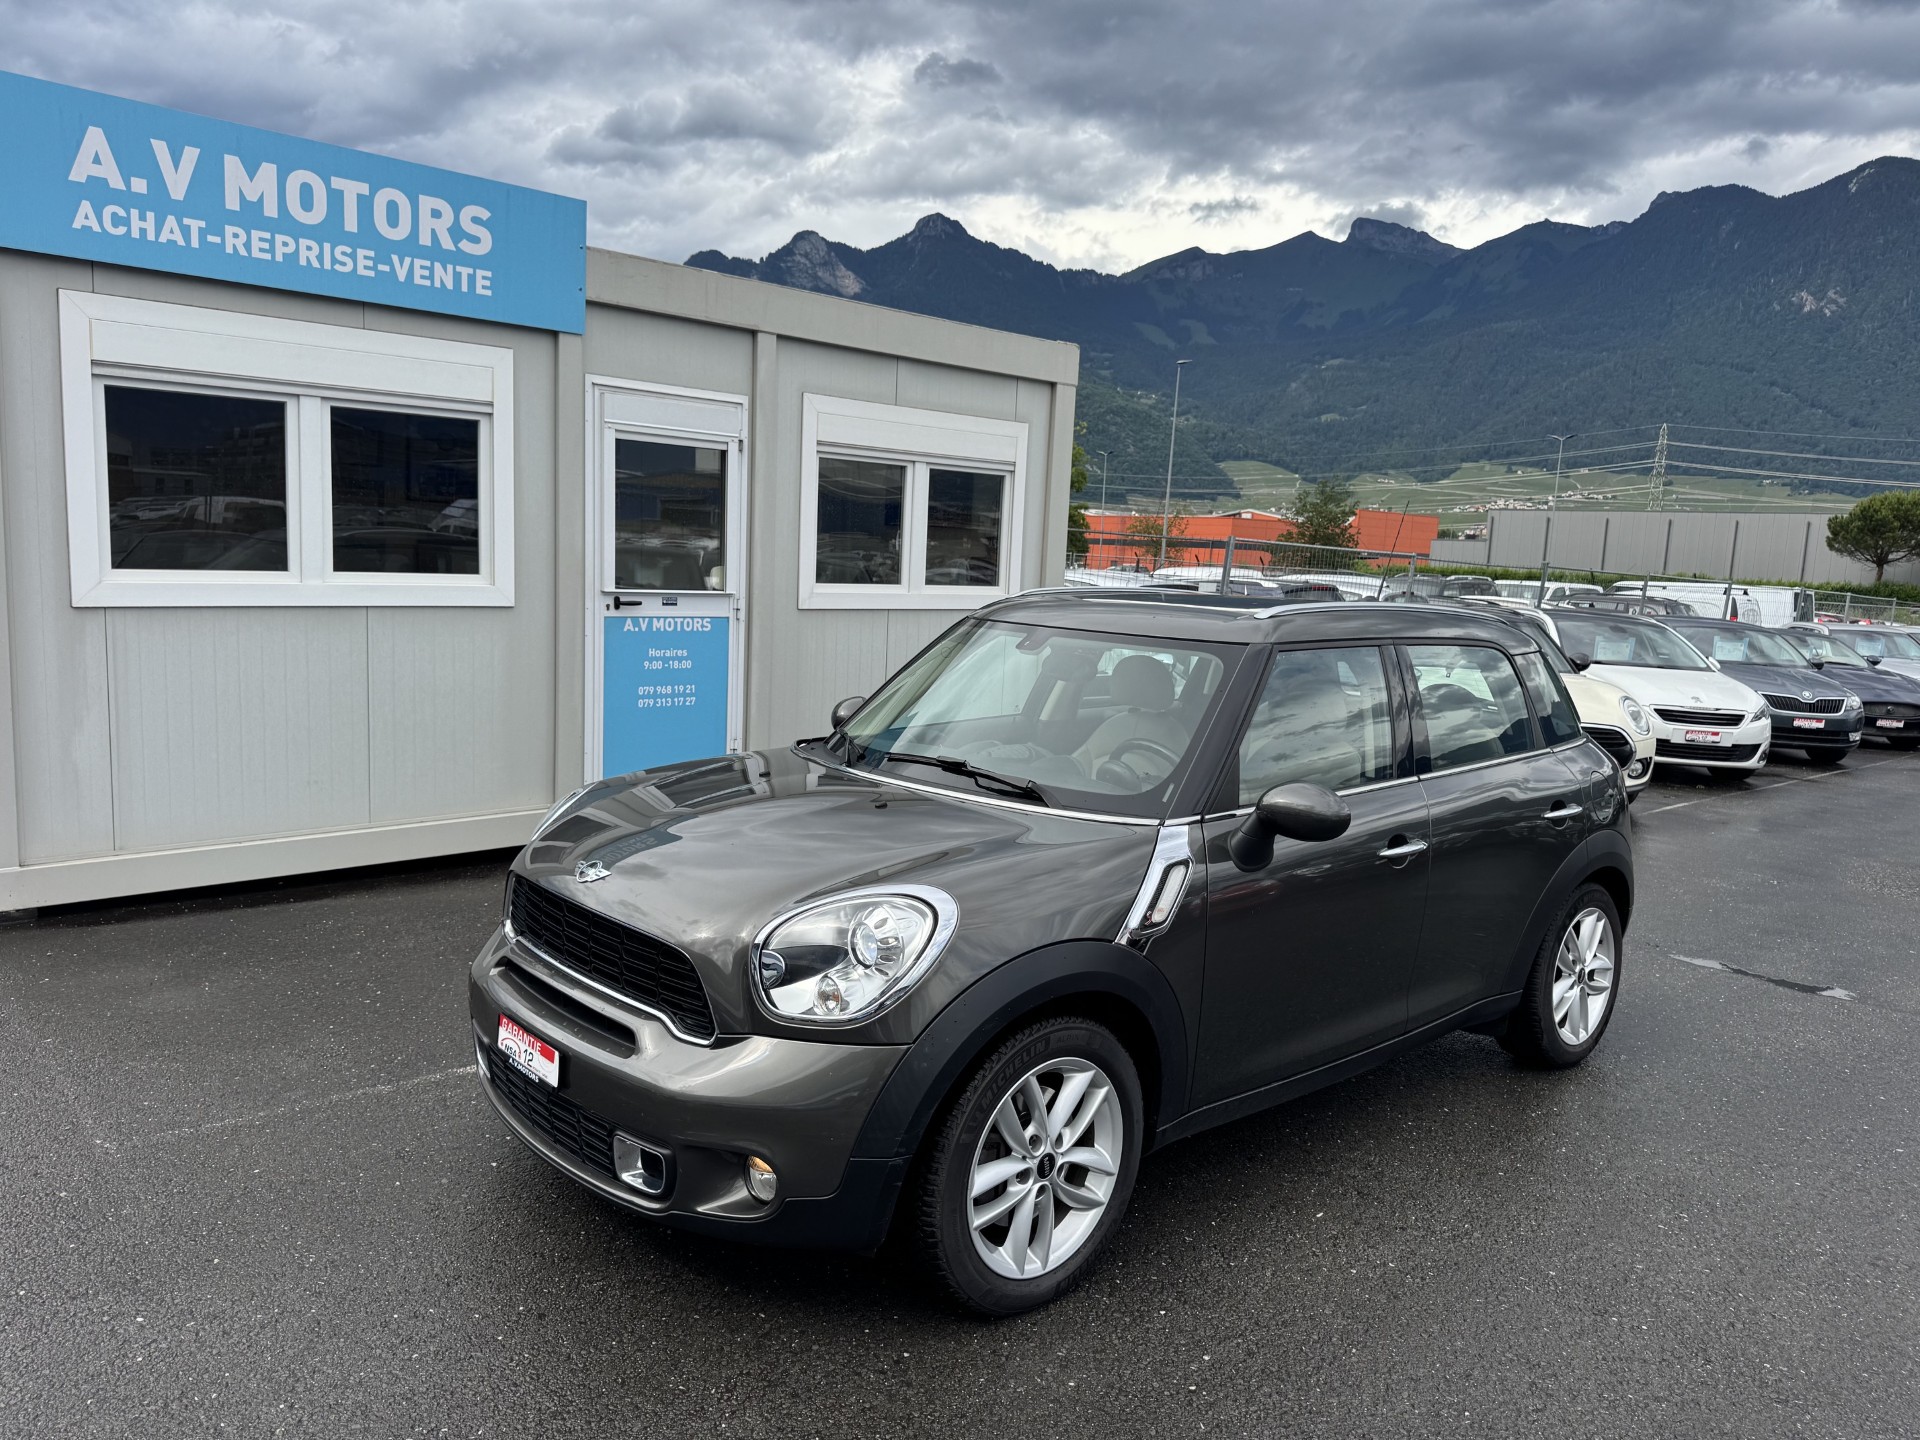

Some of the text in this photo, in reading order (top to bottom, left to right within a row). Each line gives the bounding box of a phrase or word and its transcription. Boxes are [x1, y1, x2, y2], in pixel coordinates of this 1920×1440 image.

[68, 125, 493, 256] A.V MOTORS
[71, 200, 493, 297] ACHAT-REPRISE-VENTE
[623, 617, 712, 632] A.V MOTORS
[648, 648, 688, 657] Horaires
[643, 660, 663, 670] 9:00
[638, 684, 695, 695] 079 968 19 21
[638, 697, 696, 708] 079 313 17 27
[502, 1018, 542, 1054] GARANTIE
[504, 1043, 534, 1068] NSA 12
[981, 1039, 1046, 1110] MICHELIN
